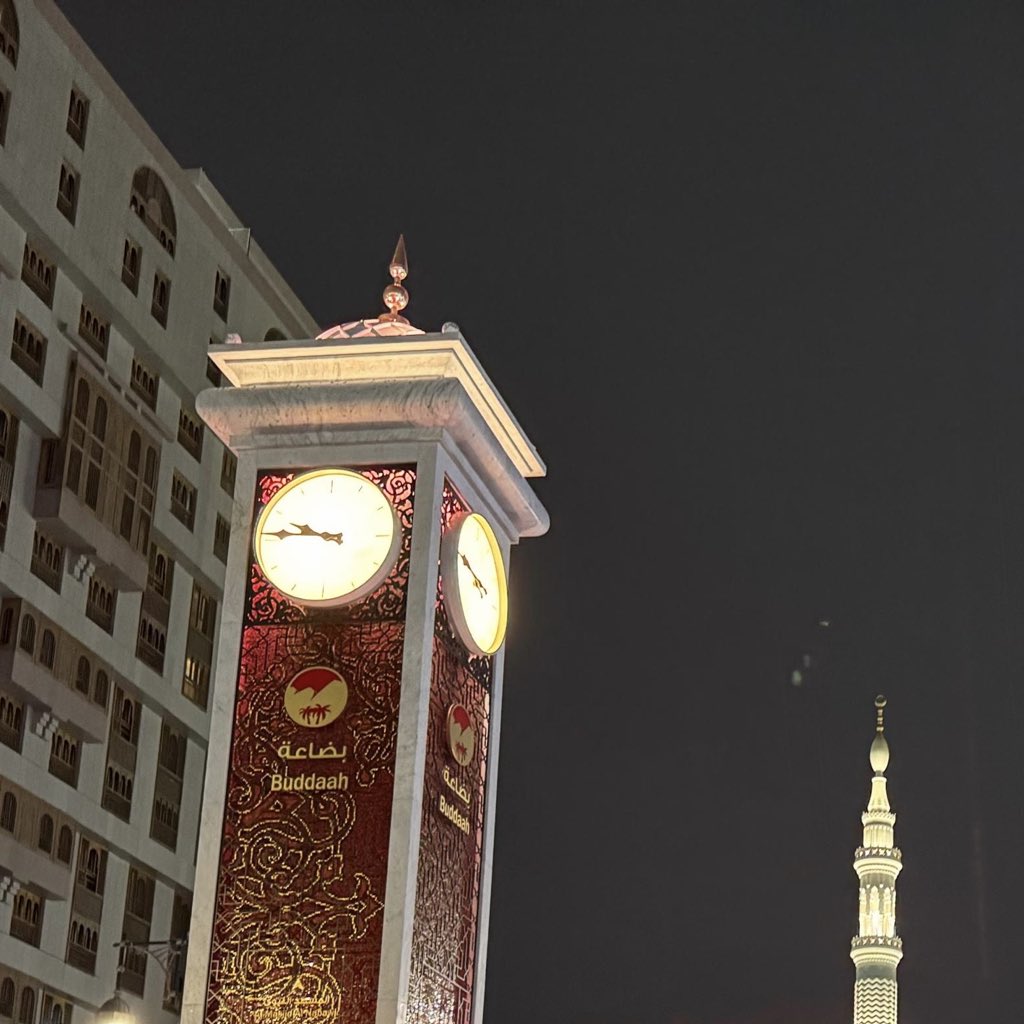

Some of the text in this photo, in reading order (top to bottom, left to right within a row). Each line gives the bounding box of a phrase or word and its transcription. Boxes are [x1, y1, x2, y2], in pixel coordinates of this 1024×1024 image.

[277, 741, 347, 763] بضاعة
[271, 772, 349, 791] Buddaah
[443, 765, 471, 809] بضاعة
[440, 795, 470, 835] Buddaah
